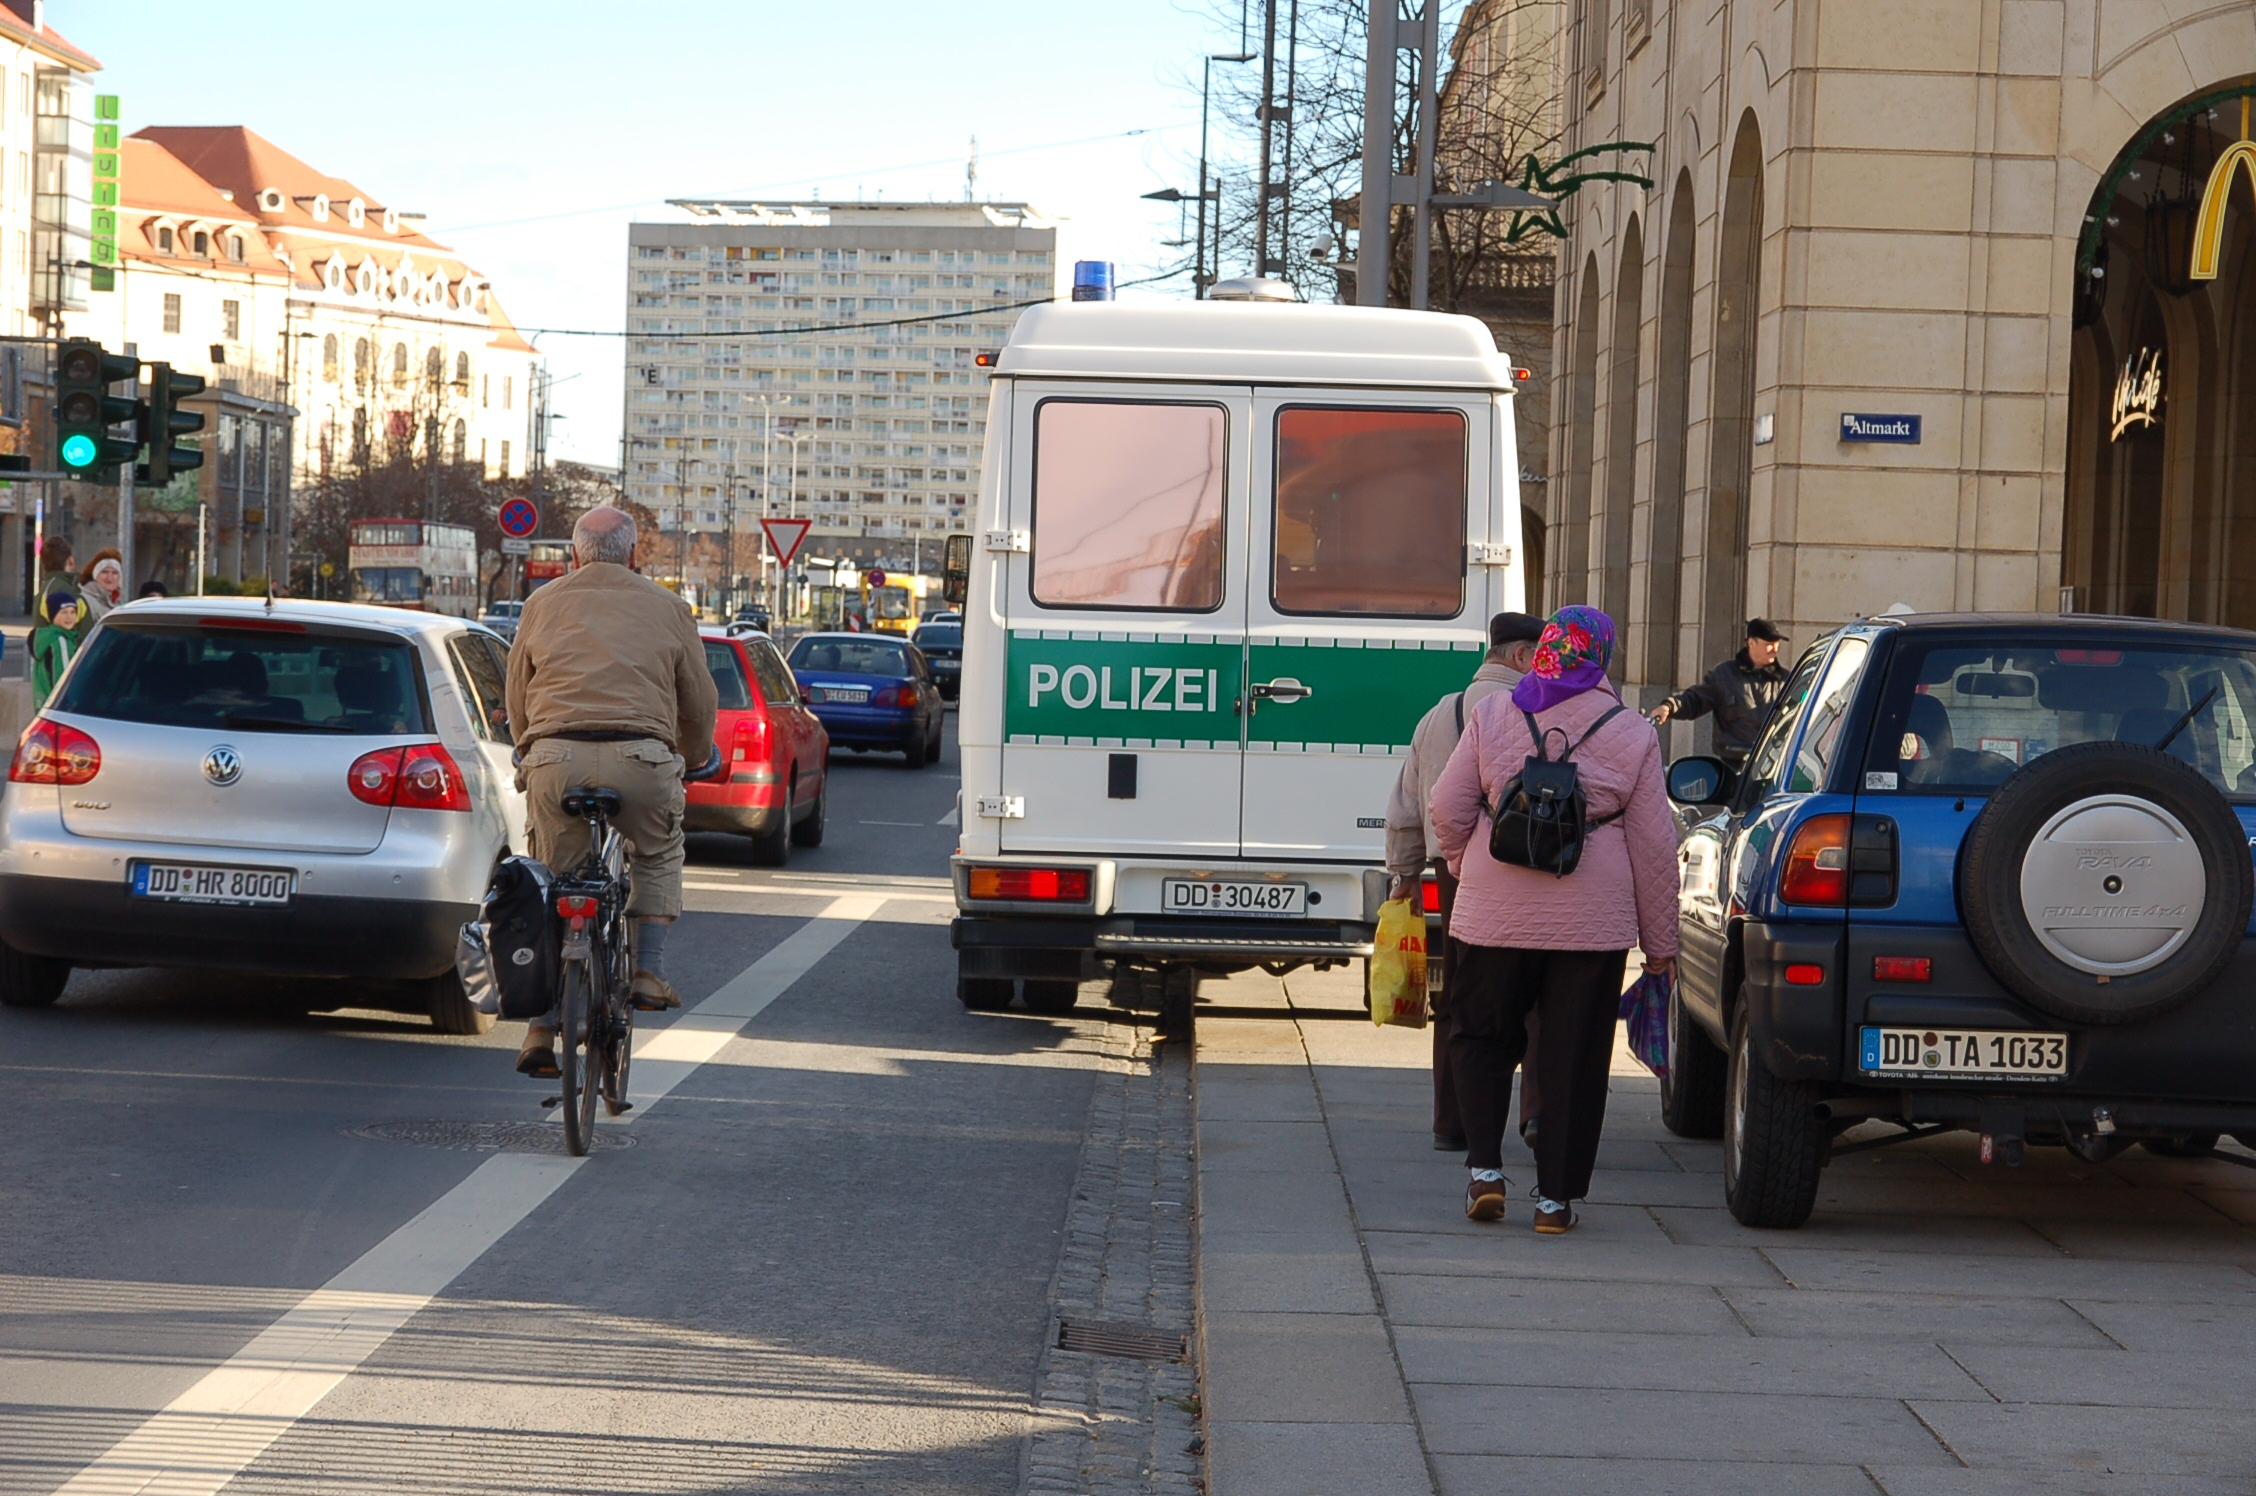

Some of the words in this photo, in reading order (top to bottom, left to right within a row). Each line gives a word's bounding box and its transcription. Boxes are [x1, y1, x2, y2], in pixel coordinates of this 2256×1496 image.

[1849, 419, 1910, 436] Altmarkt
[1028, 663, 1218, 713] POLIZEI
[2075, 848, 2112, 856] TOYOTA
[2075, 855, 2152, 871] RAV4
[150, 868, 179, 892] DD
[196, 871, 225, 895] HR
[231, 872, 287, 899] 8000
[1225, 885, 1296, 910] 30487
[2041, 906, 2092, 918] FULL
[2093, 906, 2141, 918] TIME
[1882, 1033, 1920, 1065] DD
[1944, 1035, 1980, 1067] TA
[1990, 1037, 2065, 1069] 1033
[1879, 1071, 1904, 1079] TOYOTA
